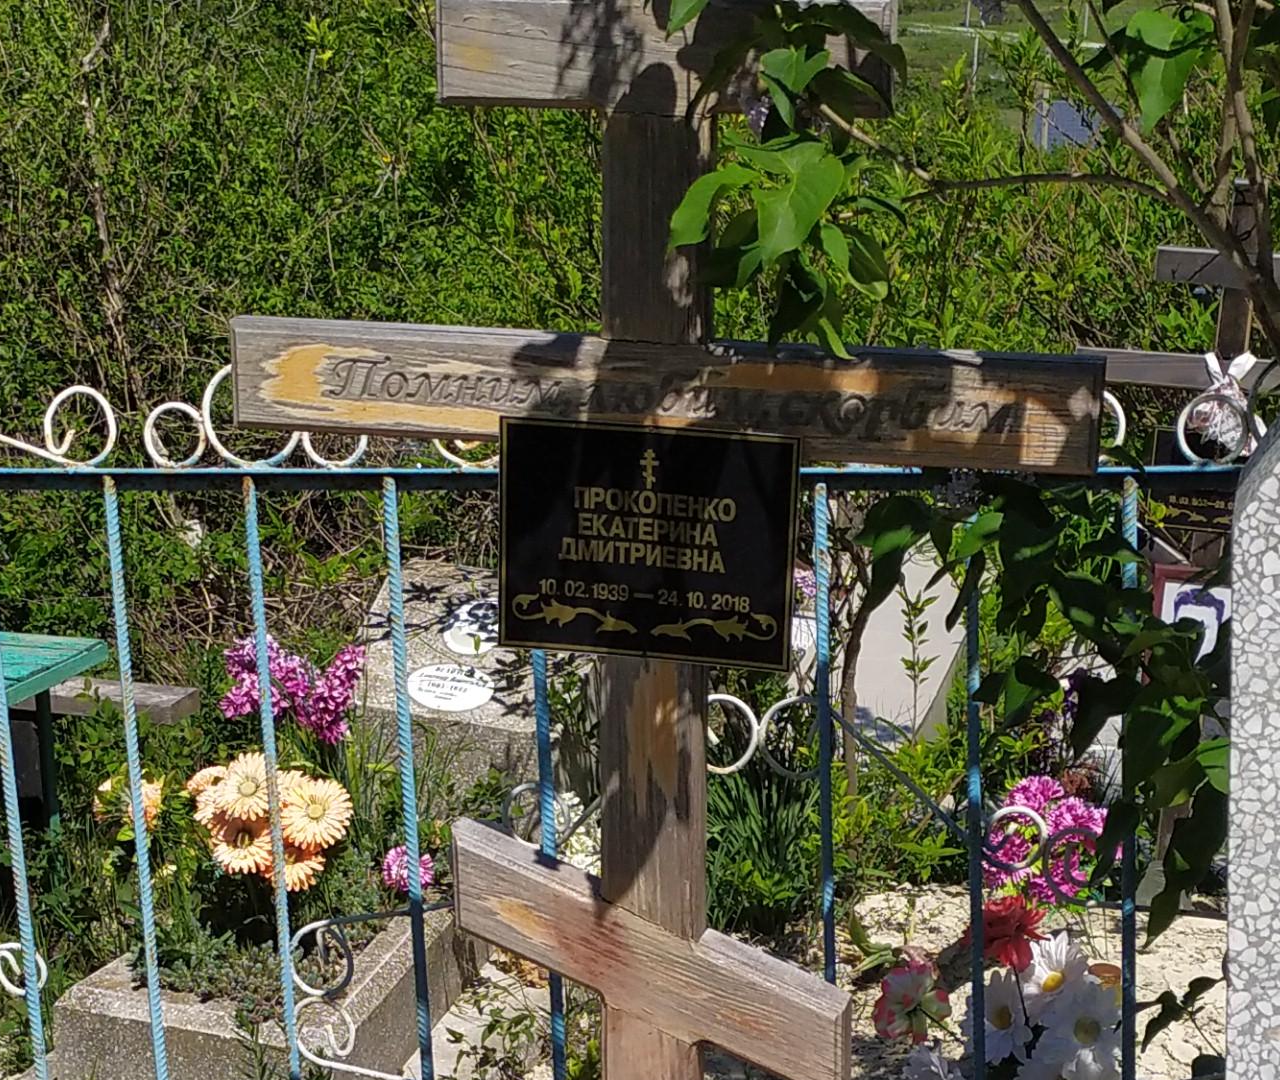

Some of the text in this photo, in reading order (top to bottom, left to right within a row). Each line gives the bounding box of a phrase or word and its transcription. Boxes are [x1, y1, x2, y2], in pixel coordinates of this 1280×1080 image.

[574, 486, 736, 522] ПРОКОПЕНКО
[578, 513, 718, 547] ЕКАТЕРИНА
[558, 538, 726, 574] ДМИТРИЕВНА
